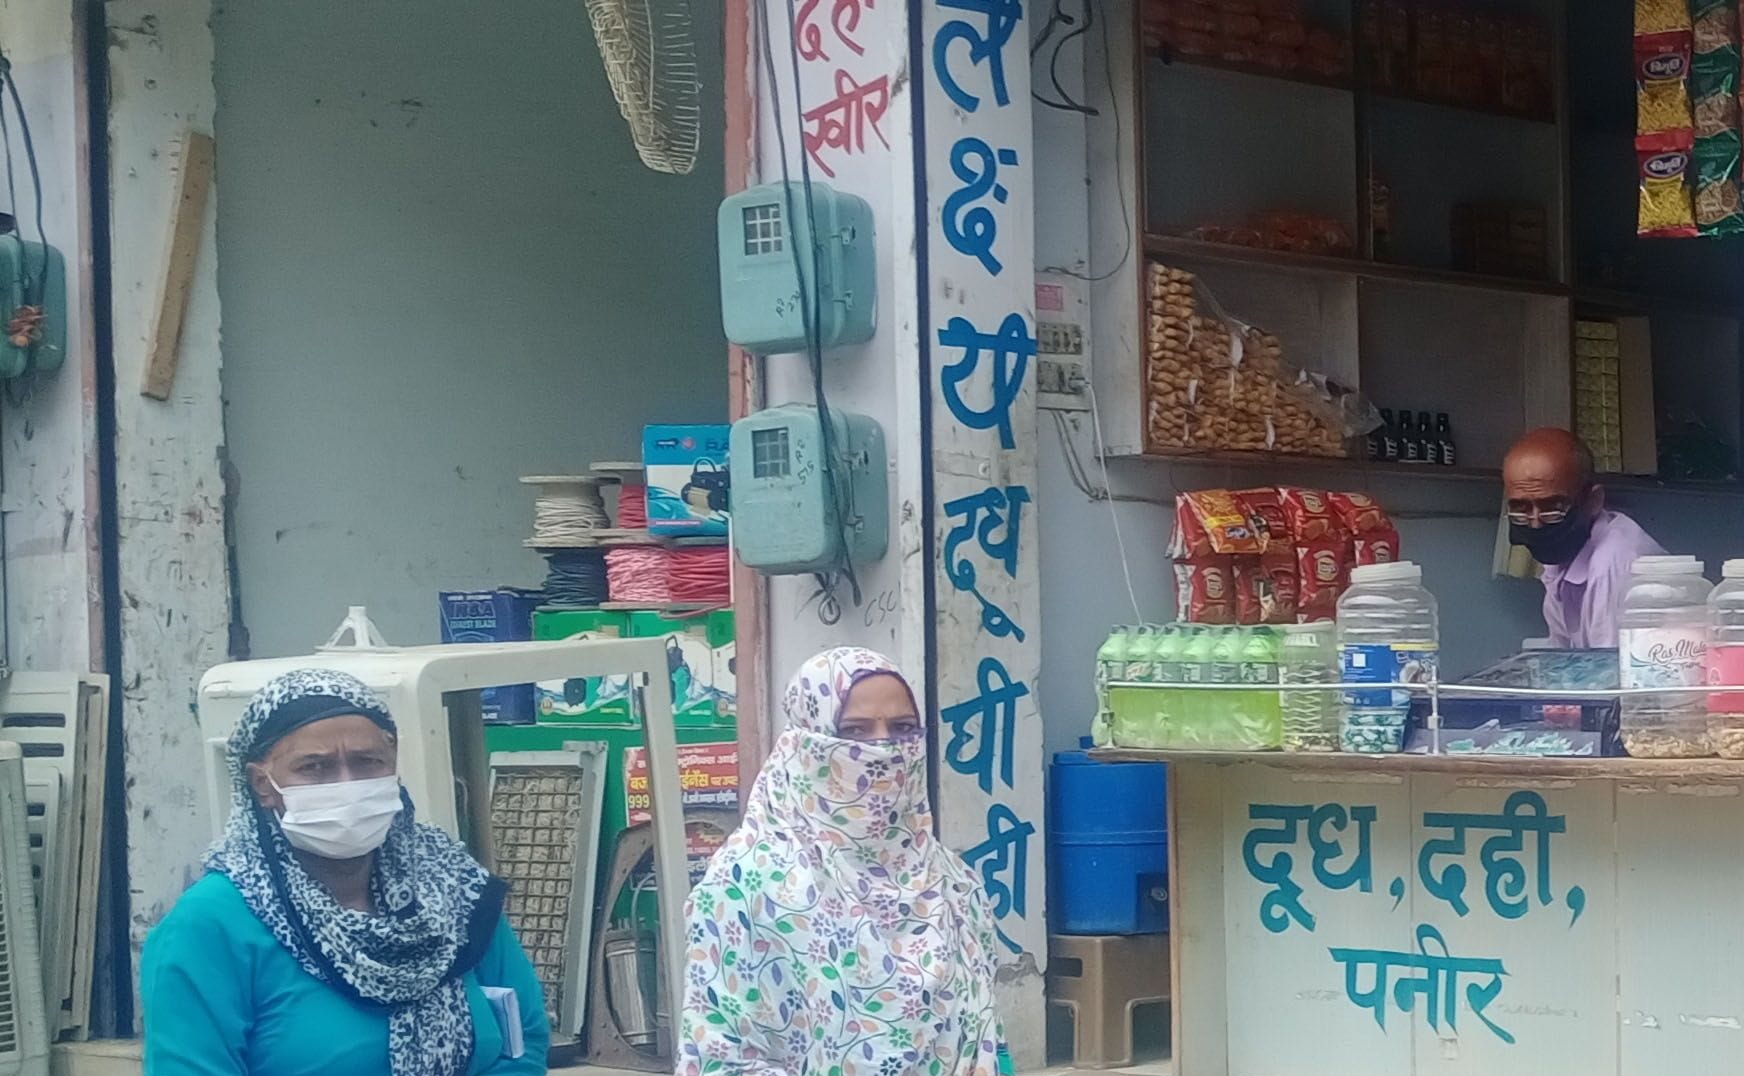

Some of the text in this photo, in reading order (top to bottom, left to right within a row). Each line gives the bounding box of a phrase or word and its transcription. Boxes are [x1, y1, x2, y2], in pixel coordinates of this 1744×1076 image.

[802, 69, 891, 178] खीर
[944, 485, 1032, 643] दूध
[941, 657, 1029, 796] घी
[960, 803, 1035, 956] ही
[1327, 923, 1516, 1044] पनीर
